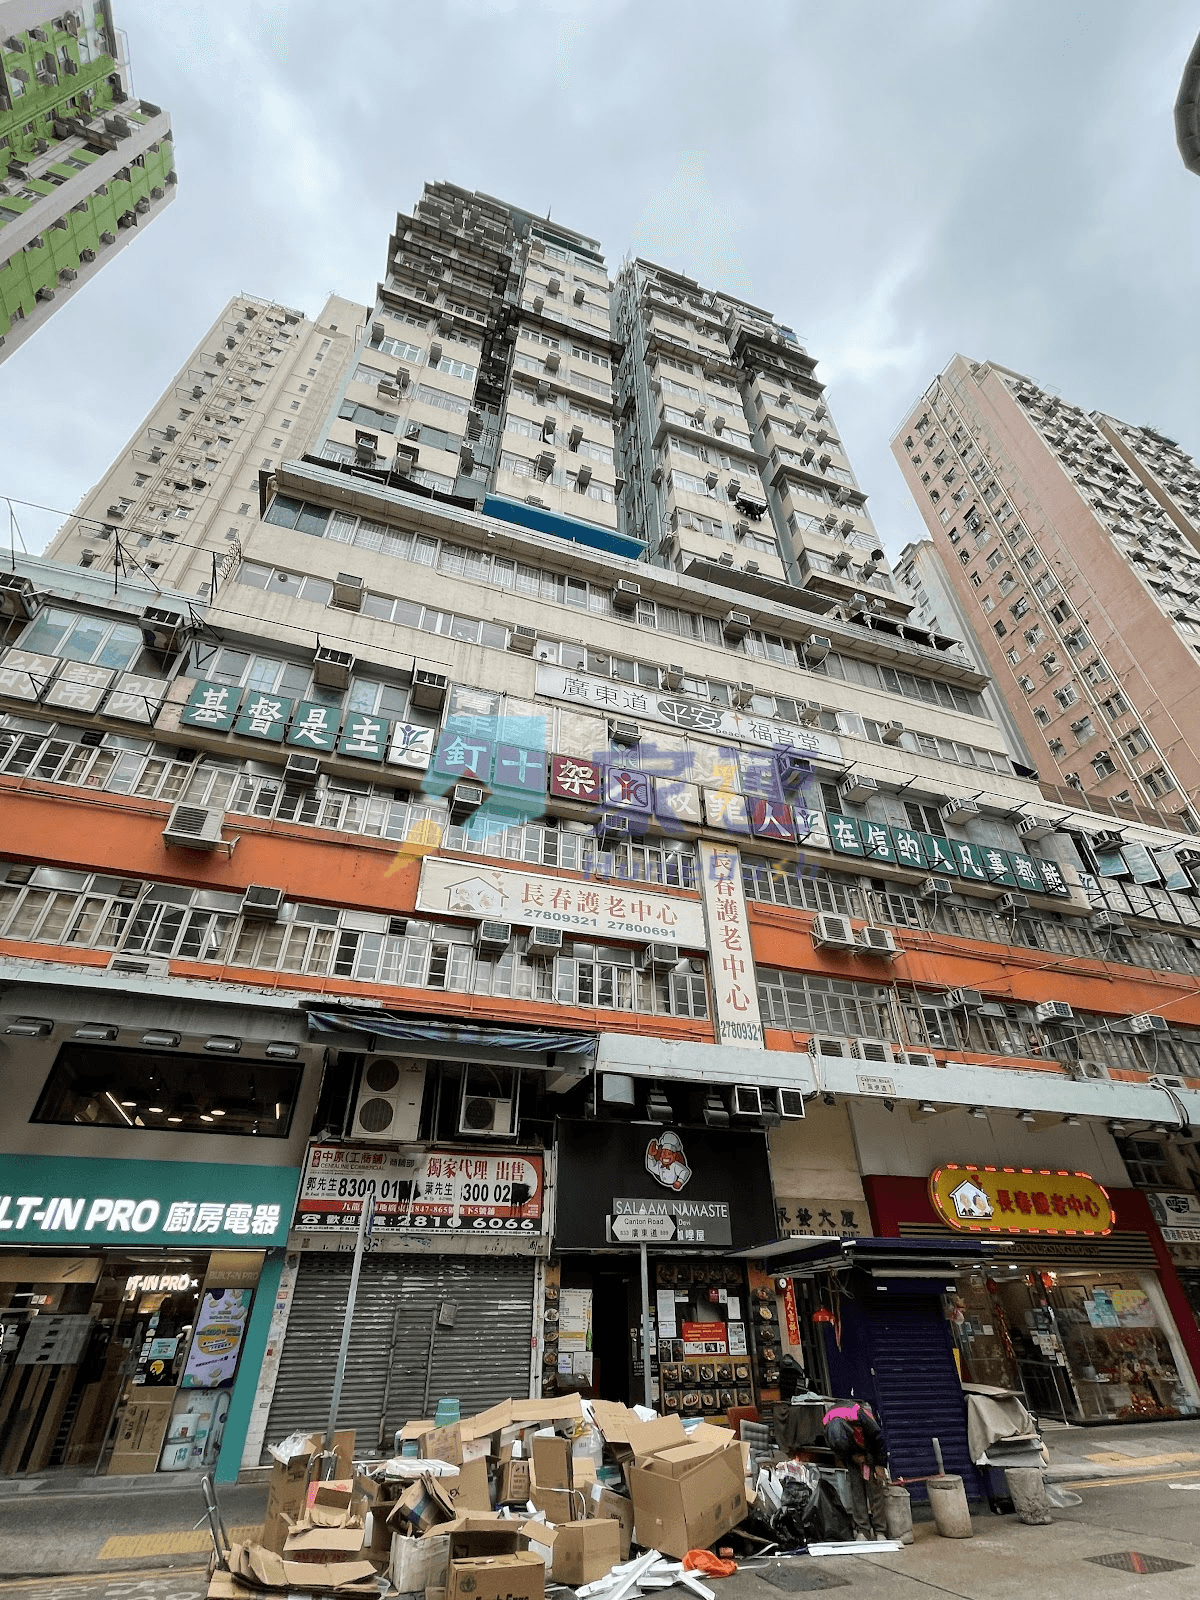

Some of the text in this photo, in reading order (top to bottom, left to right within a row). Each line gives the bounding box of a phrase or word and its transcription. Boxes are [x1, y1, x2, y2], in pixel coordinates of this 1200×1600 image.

[562, 677, 650, 714] 廣東道
[190, 688, 380, 754] 基督是主
[662, 701, 720, 729] 平安
[715, 729, 746, 739] peace
[748, 721, 820, 751] 福音堂
[444, 736, 597, 795] 釘十架
[521, 882, 679, 926] 長春護老中心
[524, 908, 677, 938] 27809321 27800691
[713, 848, 750, 1011] 長春護老中心
[721, 1020, 763, 1042] 27809321
[427, 1157, 525, 1182] 獨家代理 出售
[0, 1196, 160, 1232] LT-IN PRO
[163, 1202, 280, 1235] 廚房電器
[473, 1218, 534, 1230] 6066
[616, 1200, 728, 1218] SALAAM NAMASTE
[631, 1228, 658, 1238] 廣東道
[159, 1273, 190, 1291] PRO
